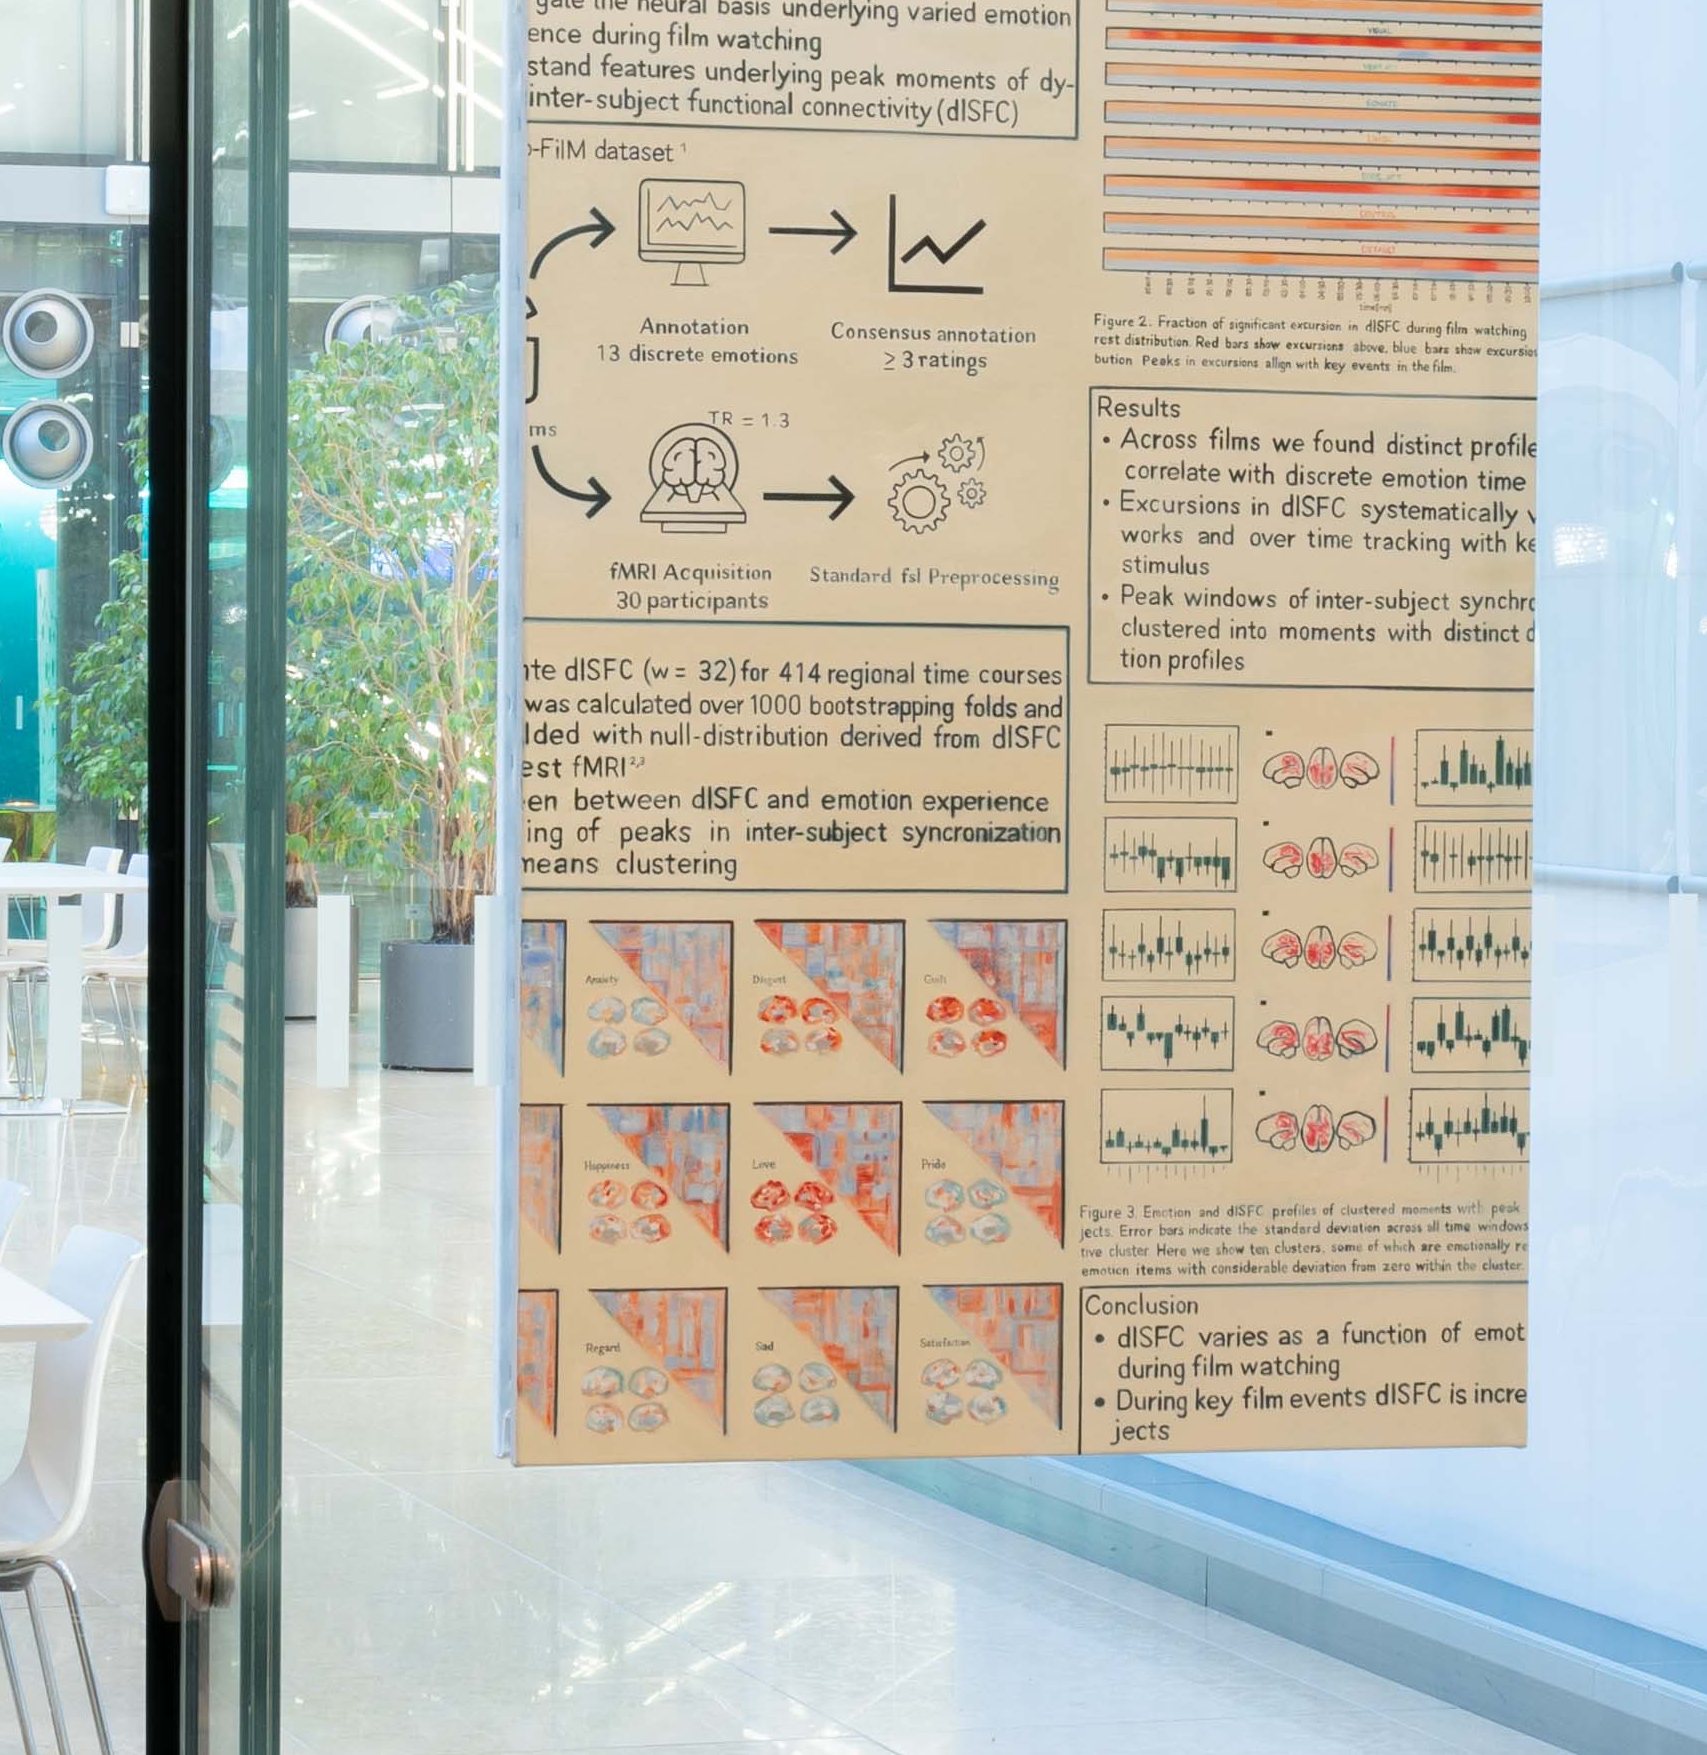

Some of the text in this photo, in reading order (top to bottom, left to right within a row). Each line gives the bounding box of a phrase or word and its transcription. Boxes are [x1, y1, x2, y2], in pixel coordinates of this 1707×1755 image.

[907, 1, 976, 23] varied
[984, 4, 1071, 27] emotion
[592, 20, 822, 61] during film watching
[686, 87, 793, 116] functional
[801, 96, 933, 128] connectivity
[639, 316, 749, 335] Annotation
[830, 321, 1036, 344] Consensus annotation
[1093, 312, 1342, 334] Figure Fraction of significant excursion
[597, 343, 799, 365] 13 discrete emotions
[1097, 394, 1181, 419] Results
[1120, 426, 1463, 457] Across films we found distinct
[610, 561, 772, 586] fMRI Acquisition
[810, 566, 1060, 596] Standard Preprocessing
[616, 590, 769, 615] 30 participants
[1084, 1292, 1199, 1316] Conclusion
